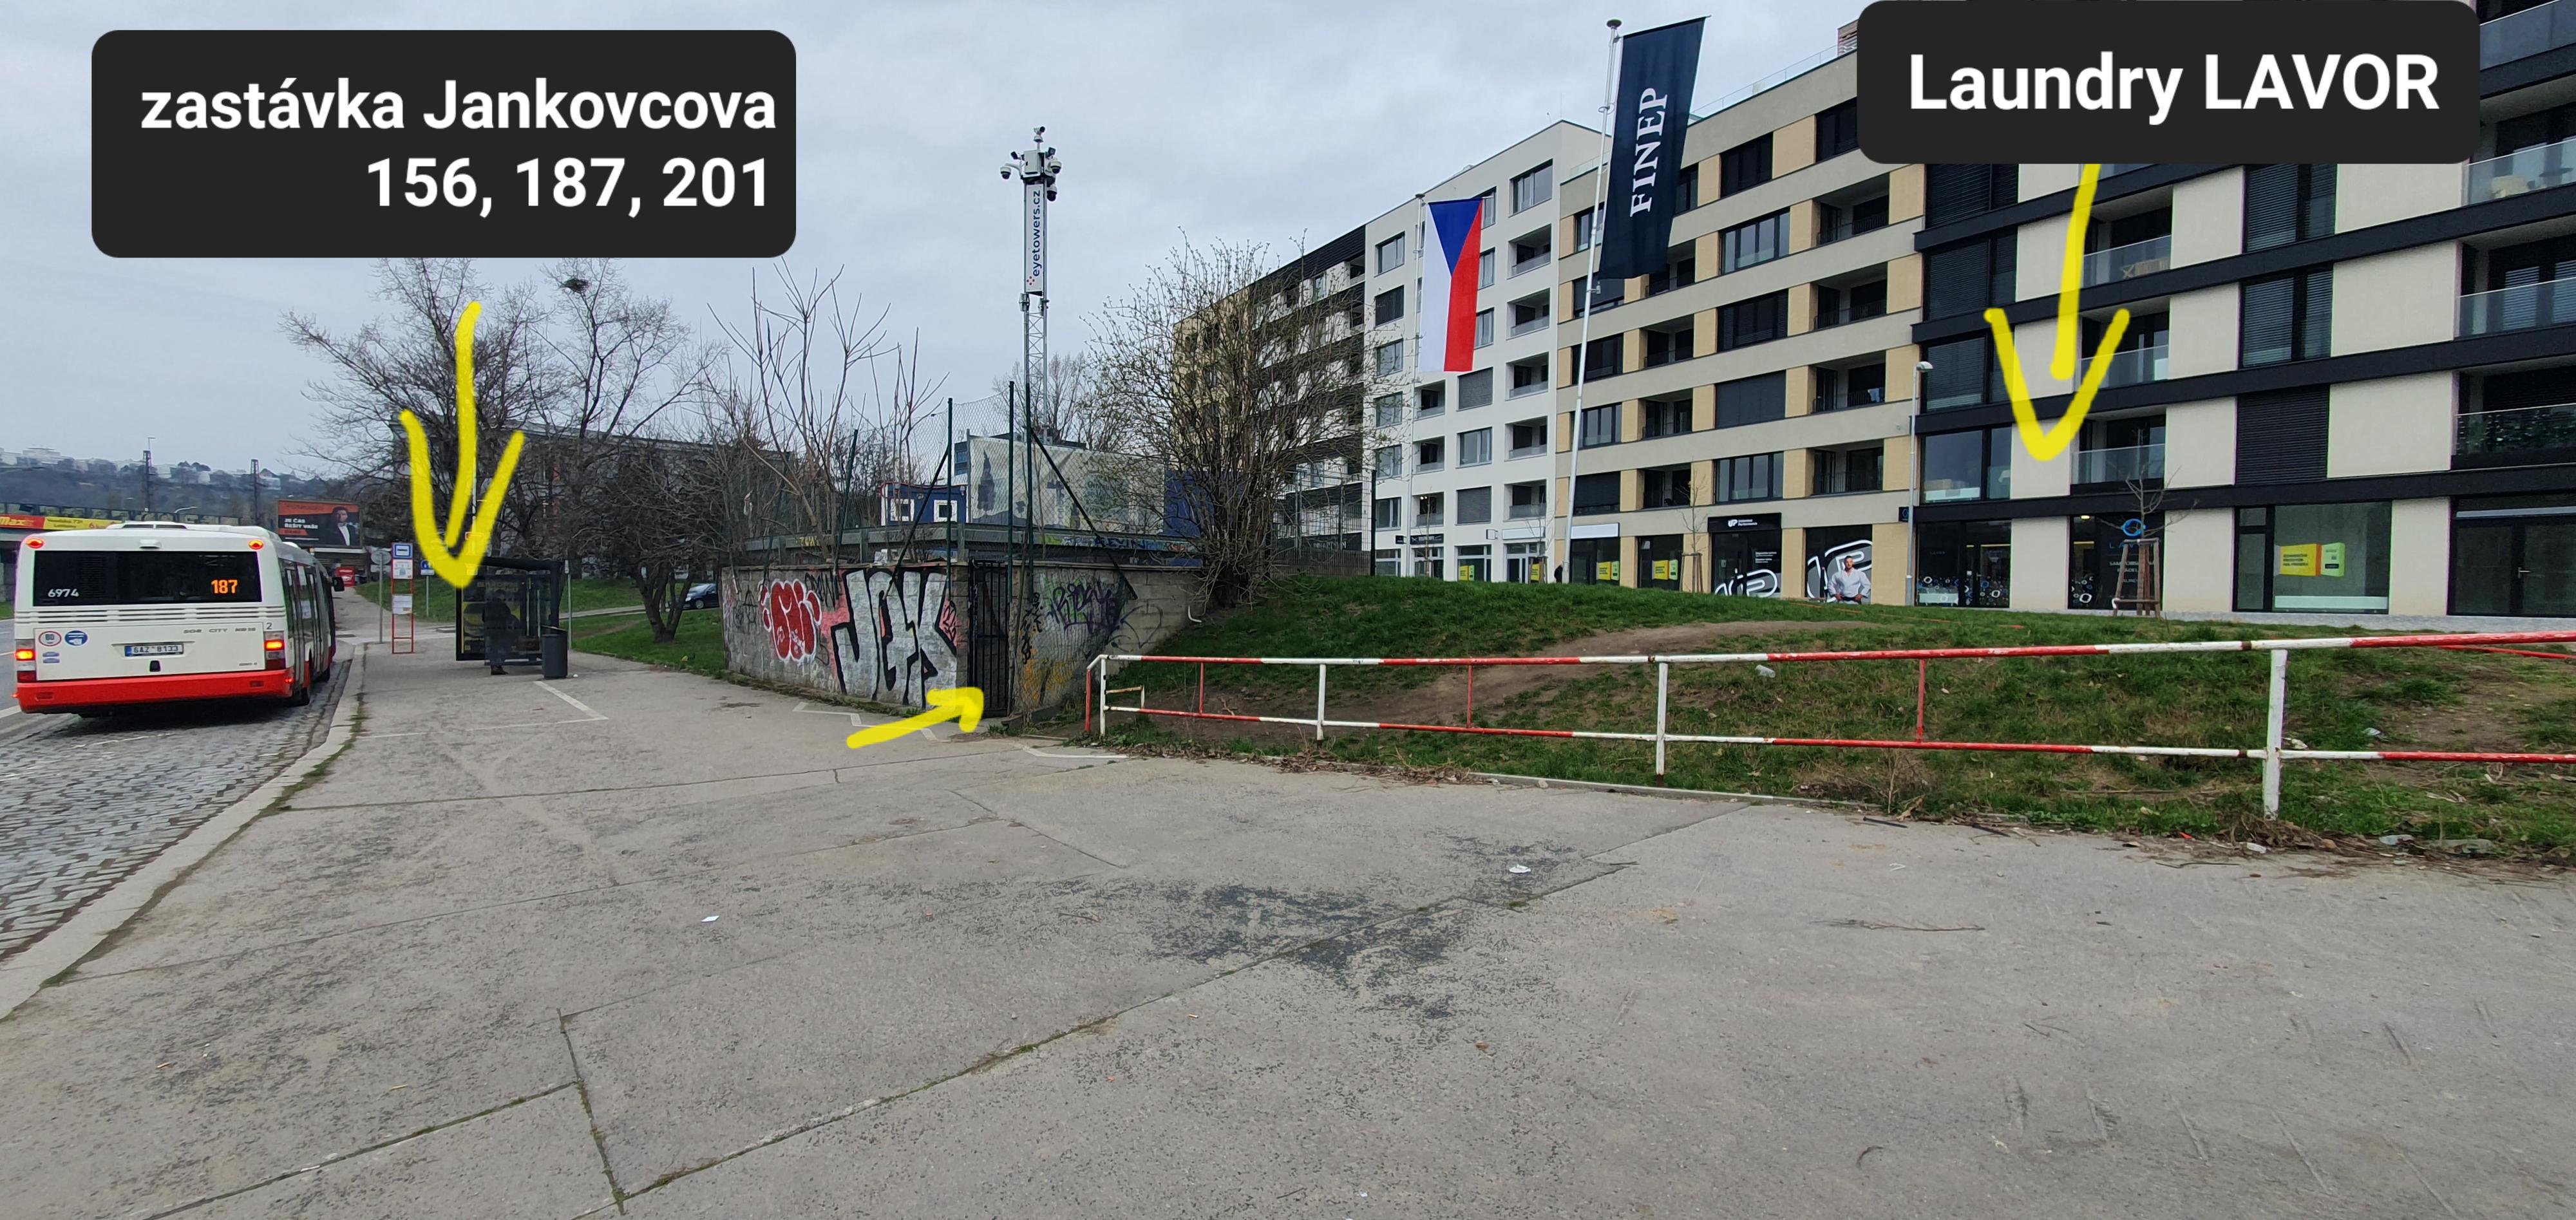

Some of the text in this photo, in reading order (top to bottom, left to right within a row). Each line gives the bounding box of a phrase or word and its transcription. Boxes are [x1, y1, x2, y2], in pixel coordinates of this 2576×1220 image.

[1629, 88, 1668, 218] FINEP
[1032, 189, 1042, 277] eyetowers.cz
[47, 588, 80, 597] 6974
[211, 579, 238, 594] 187
